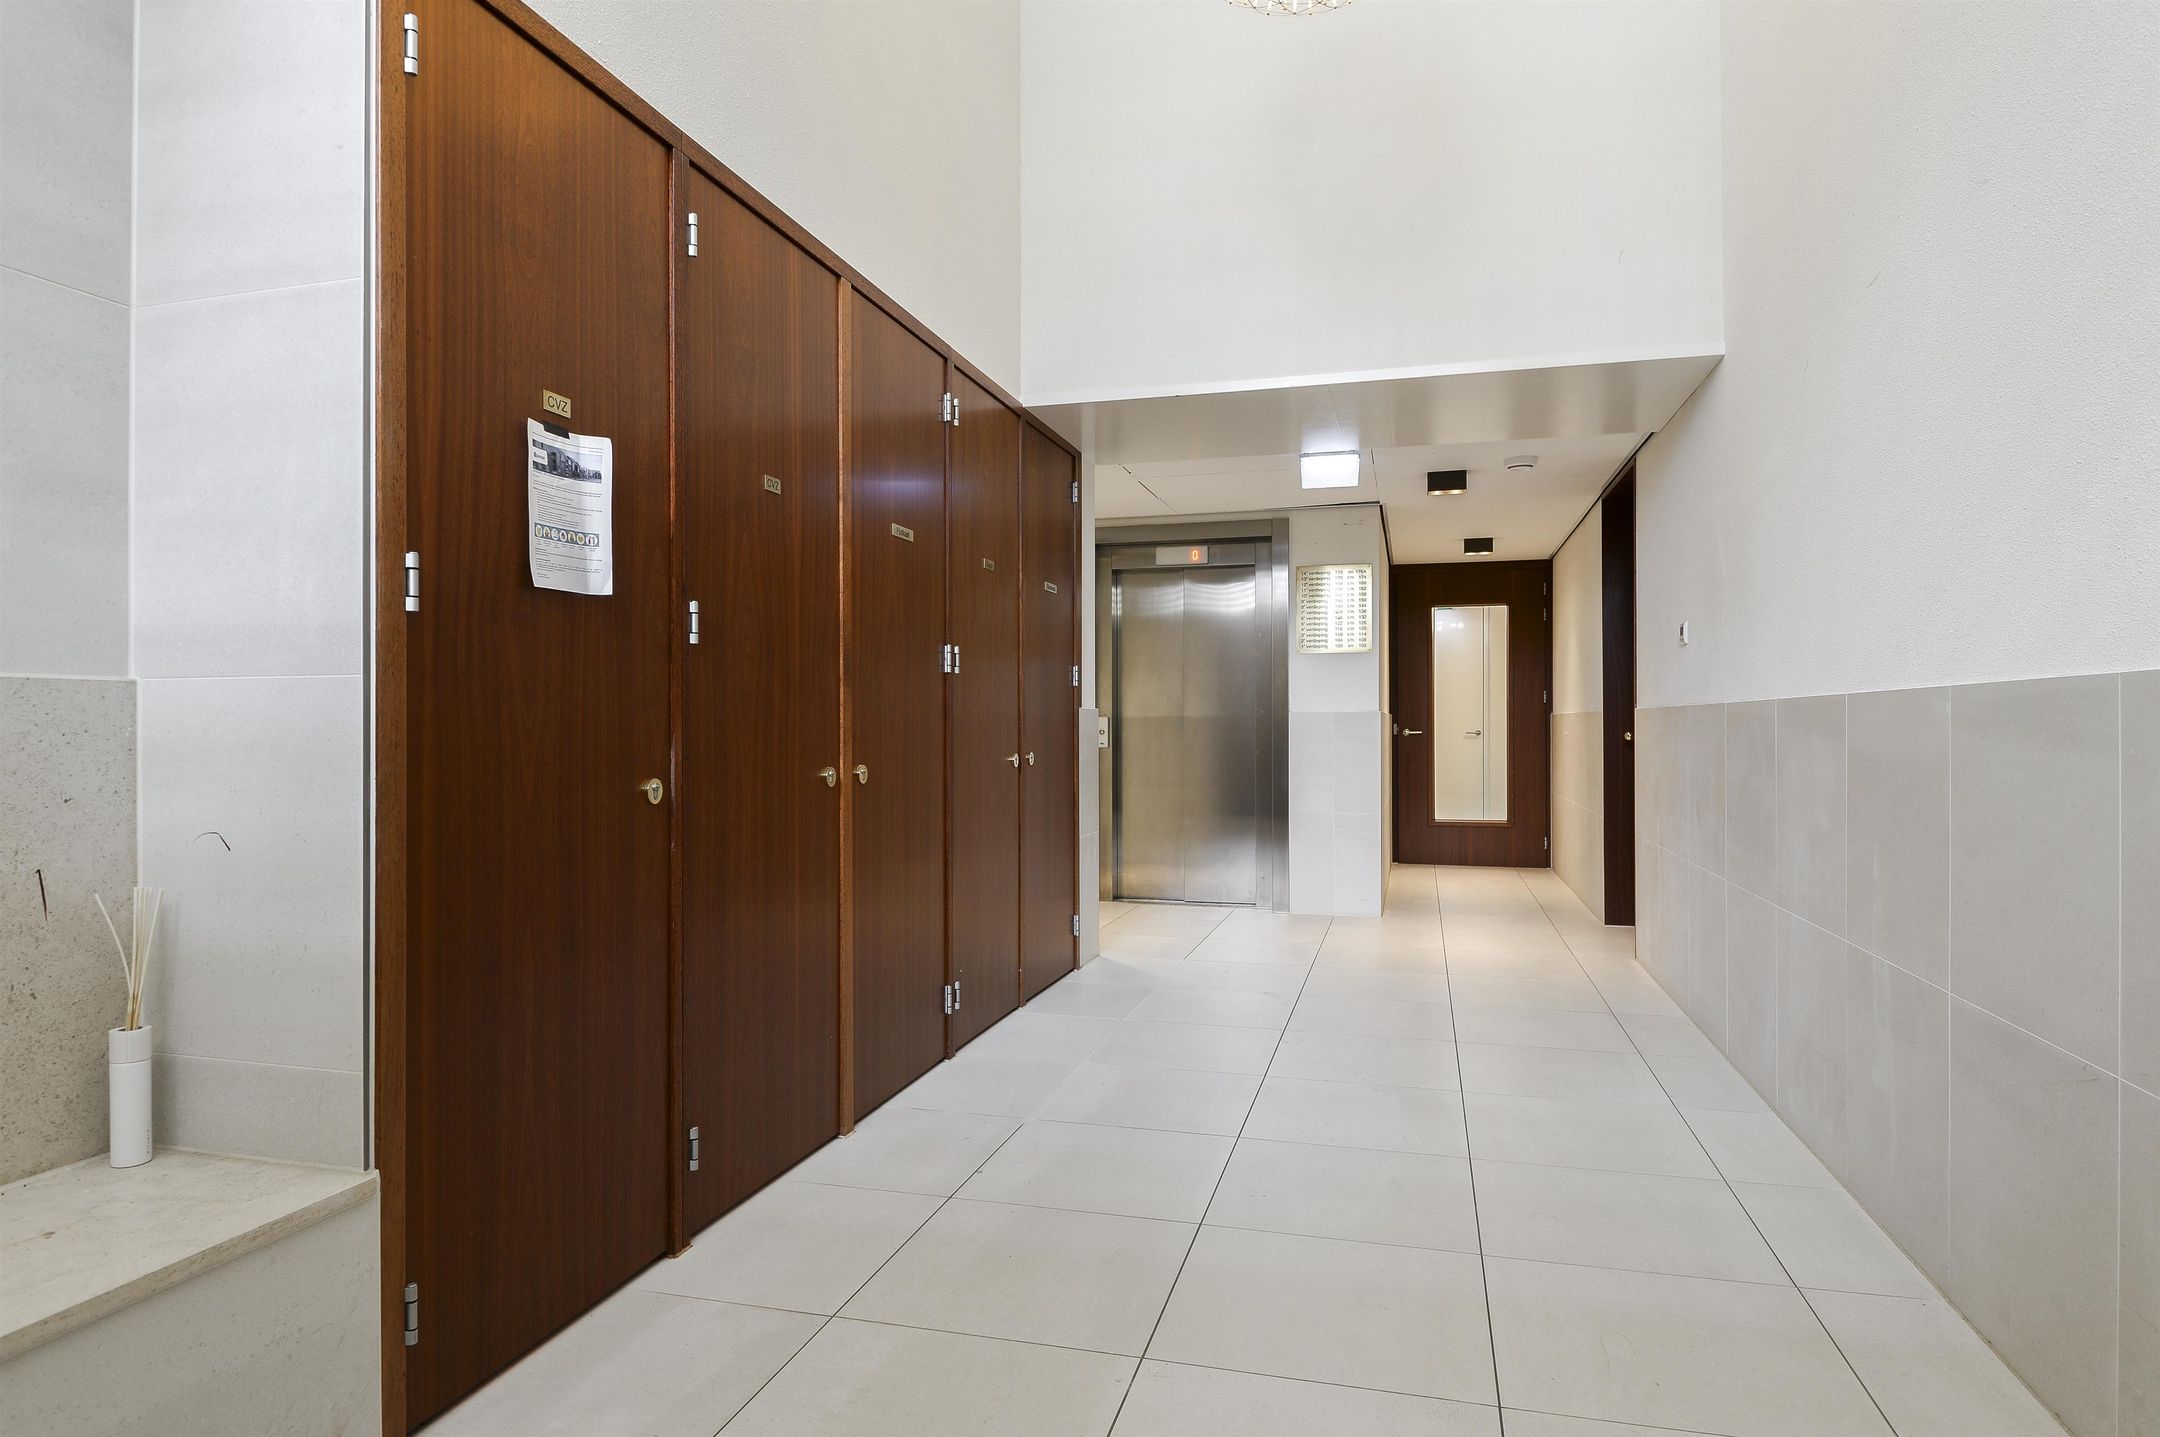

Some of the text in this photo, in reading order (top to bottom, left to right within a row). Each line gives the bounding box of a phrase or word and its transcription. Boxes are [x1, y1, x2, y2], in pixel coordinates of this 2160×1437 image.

[547, 395, 568, 414] CVZ
[767, 478, 780, 491] CVZ
[1192, 550, 1199, 561] 0
